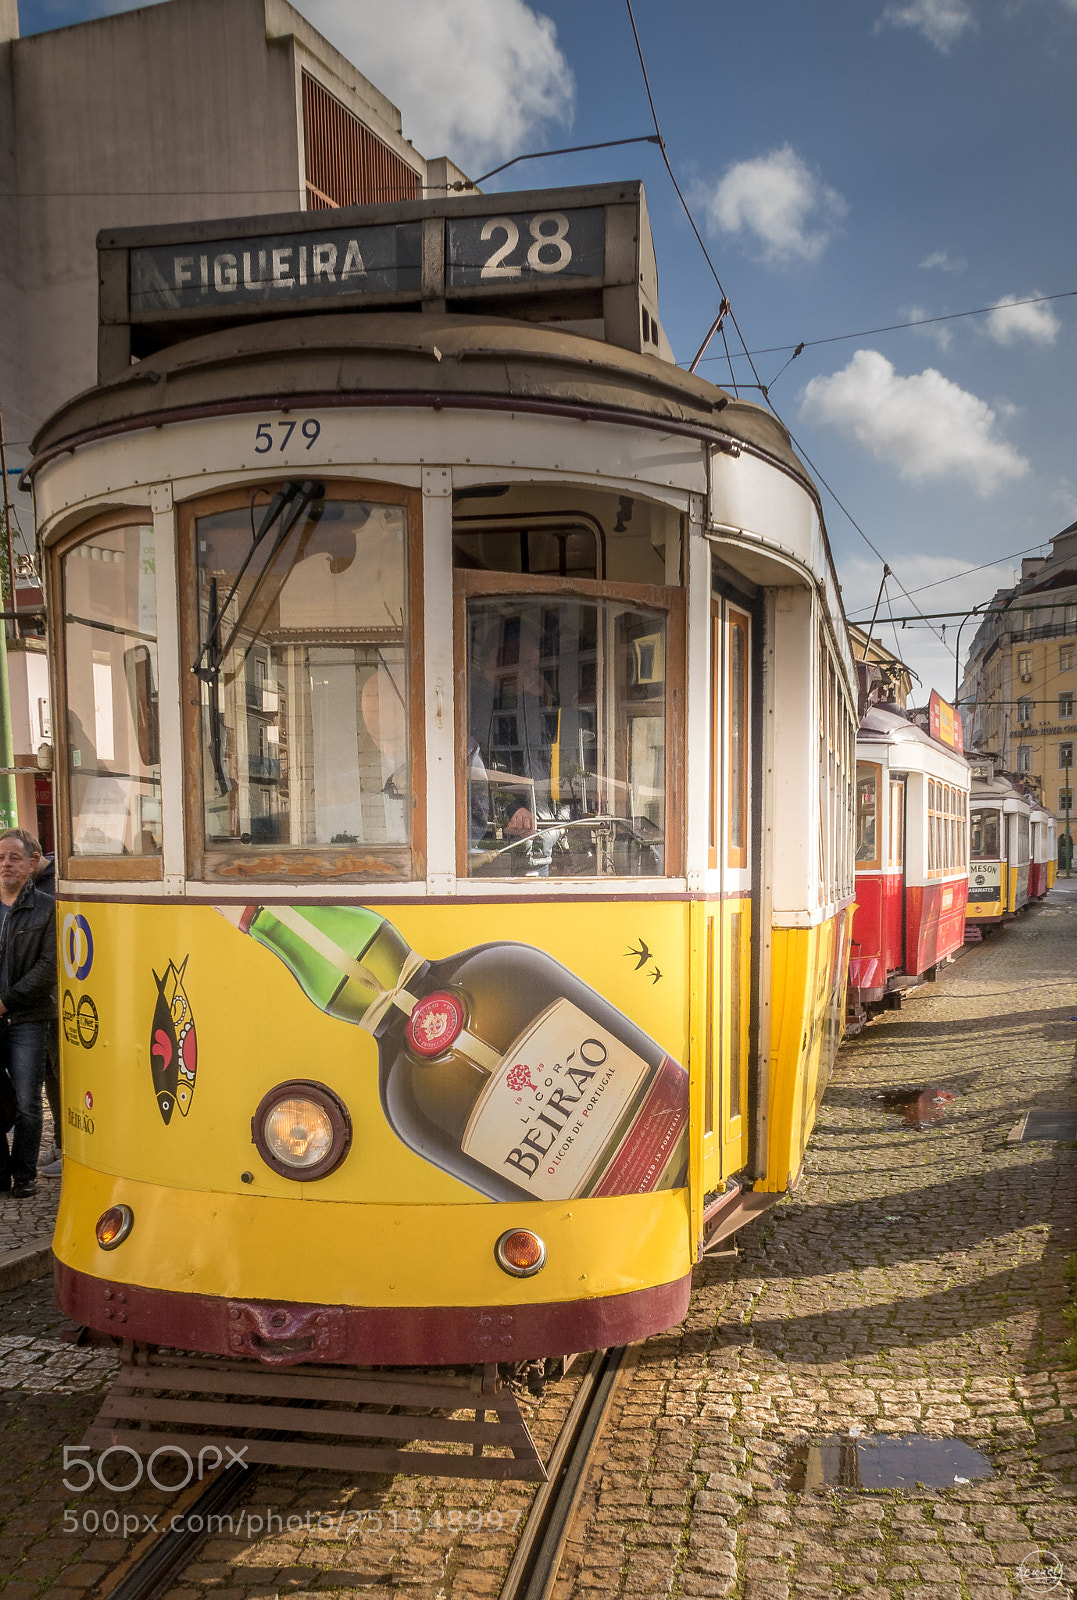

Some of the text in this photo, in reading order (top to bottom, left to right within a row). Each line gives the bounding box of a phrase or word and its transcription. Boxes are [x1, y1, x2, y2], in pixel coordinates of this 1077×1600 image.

[174, 240, 367, 295] FIGUEIRA
[480, 212, 572, 279] 28
[254, 418, 321, 454] 579
[970, 864, 998, 875] MESON
[504, 1038, 608, 1180] BEIRÃO
[520, 1063, 563, 1124] LICOR
[547, 1166, 556, 1175] O
[552, 1136, 575, 1166] LICOR
[572, 1119, 585, 1135] DE
[582, 1067, 616, 1128] PORTUGAL
[638, 1164, 657, 1194] OTTLED
[654, 1152, 662, 1162] IN
[660, 1113, 681, 1150] PORTUGAL
